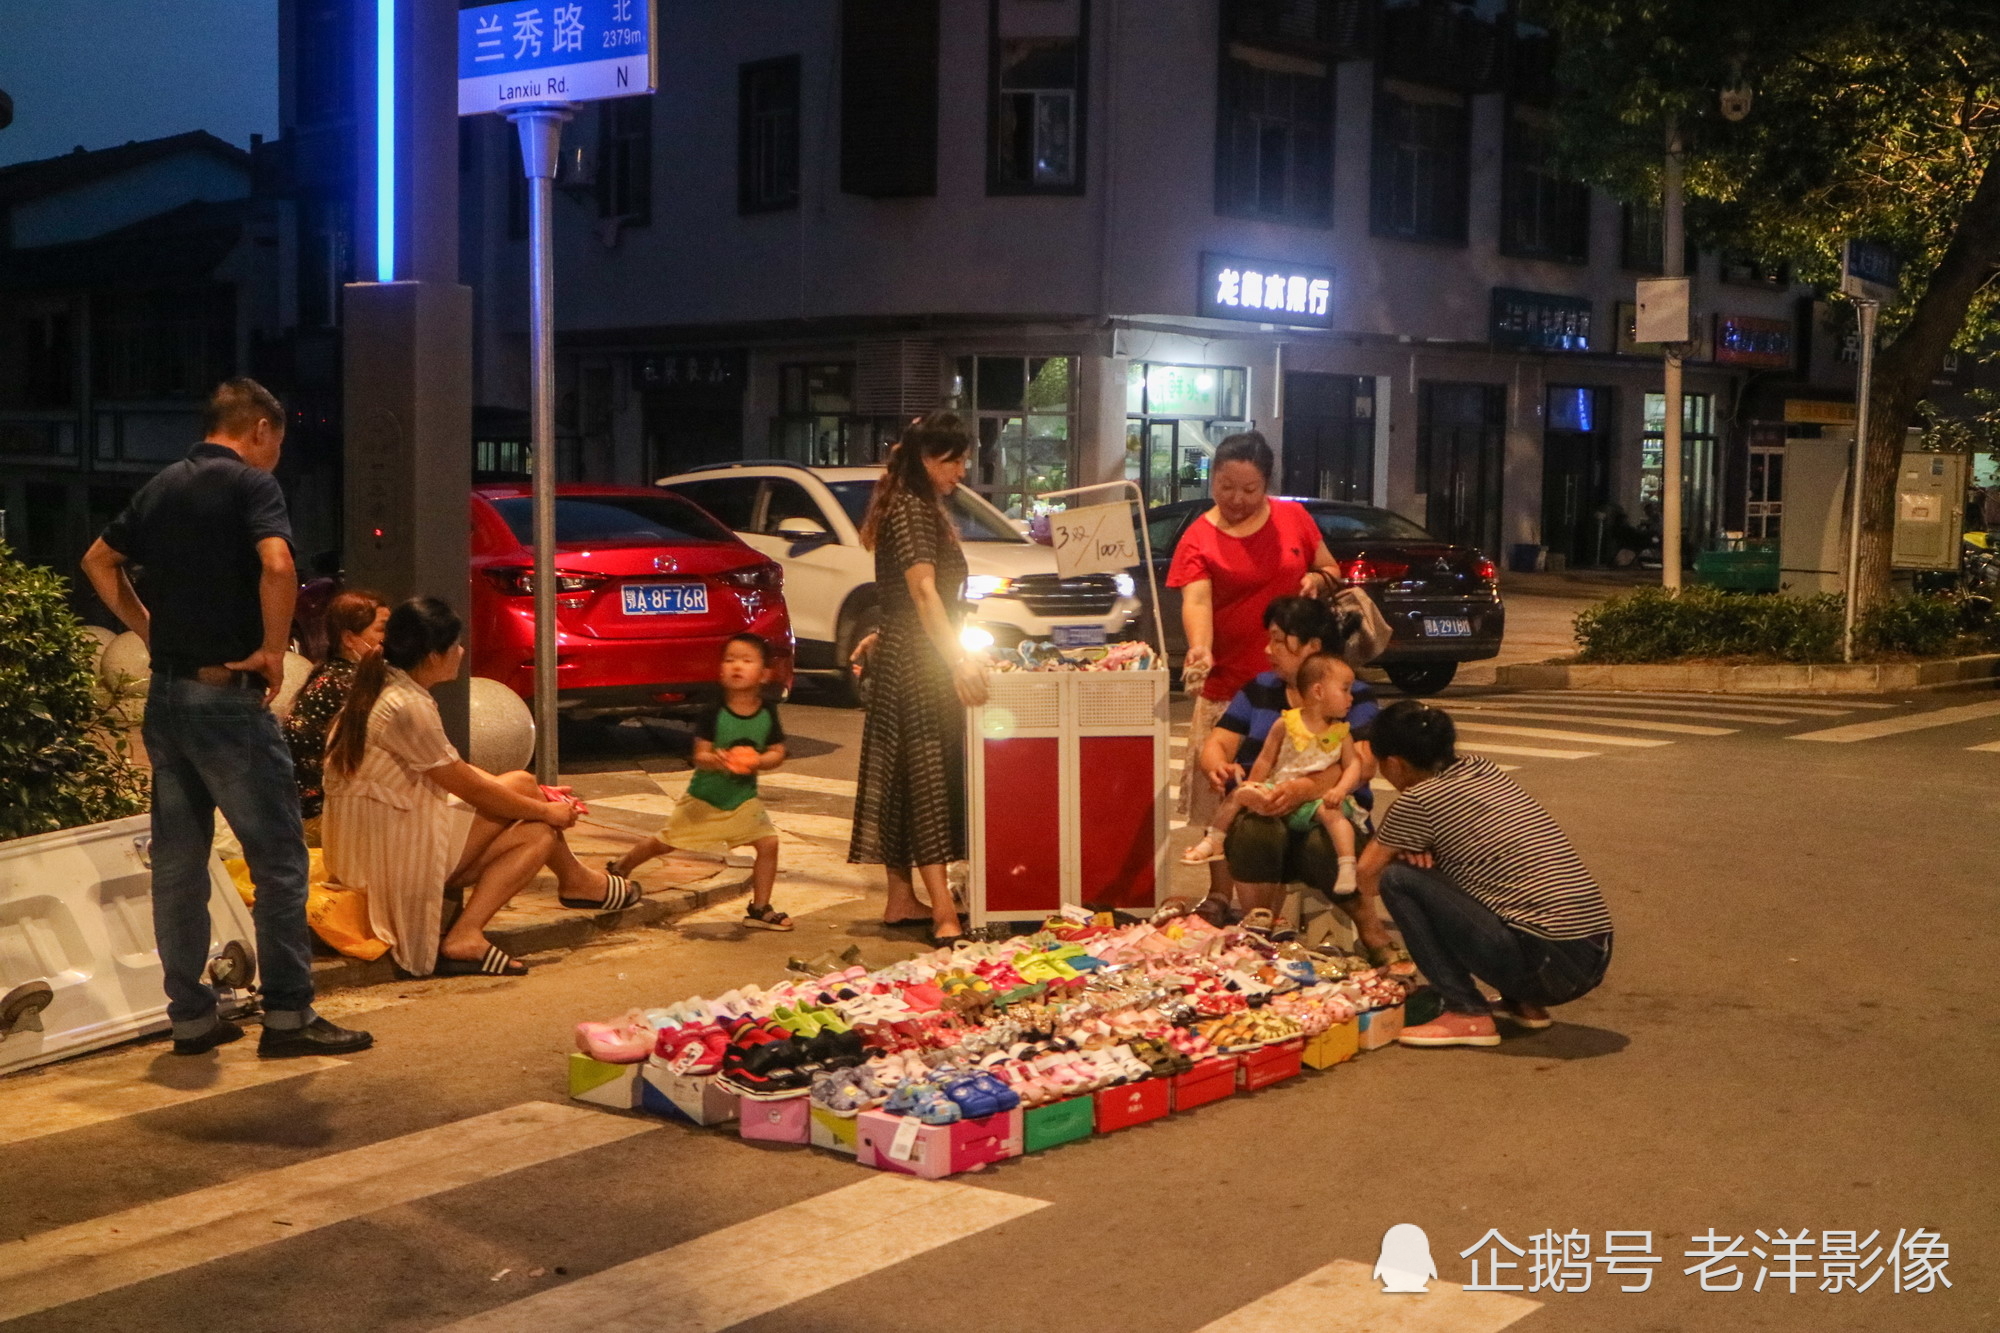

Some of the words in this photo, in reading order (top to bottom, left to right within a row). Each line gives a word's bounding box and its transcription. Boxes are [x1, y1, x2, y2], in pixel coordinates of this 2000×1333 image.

[612, 0, 632, 23] 北
[475, 2, 585, 62] 兰秀路
[603, 28, 642, 49] 2379m
[499, 80, 541, 100] Lanxiu
[547, 76, 569, 94] Rd.
[616, 65, 628, 88] N
